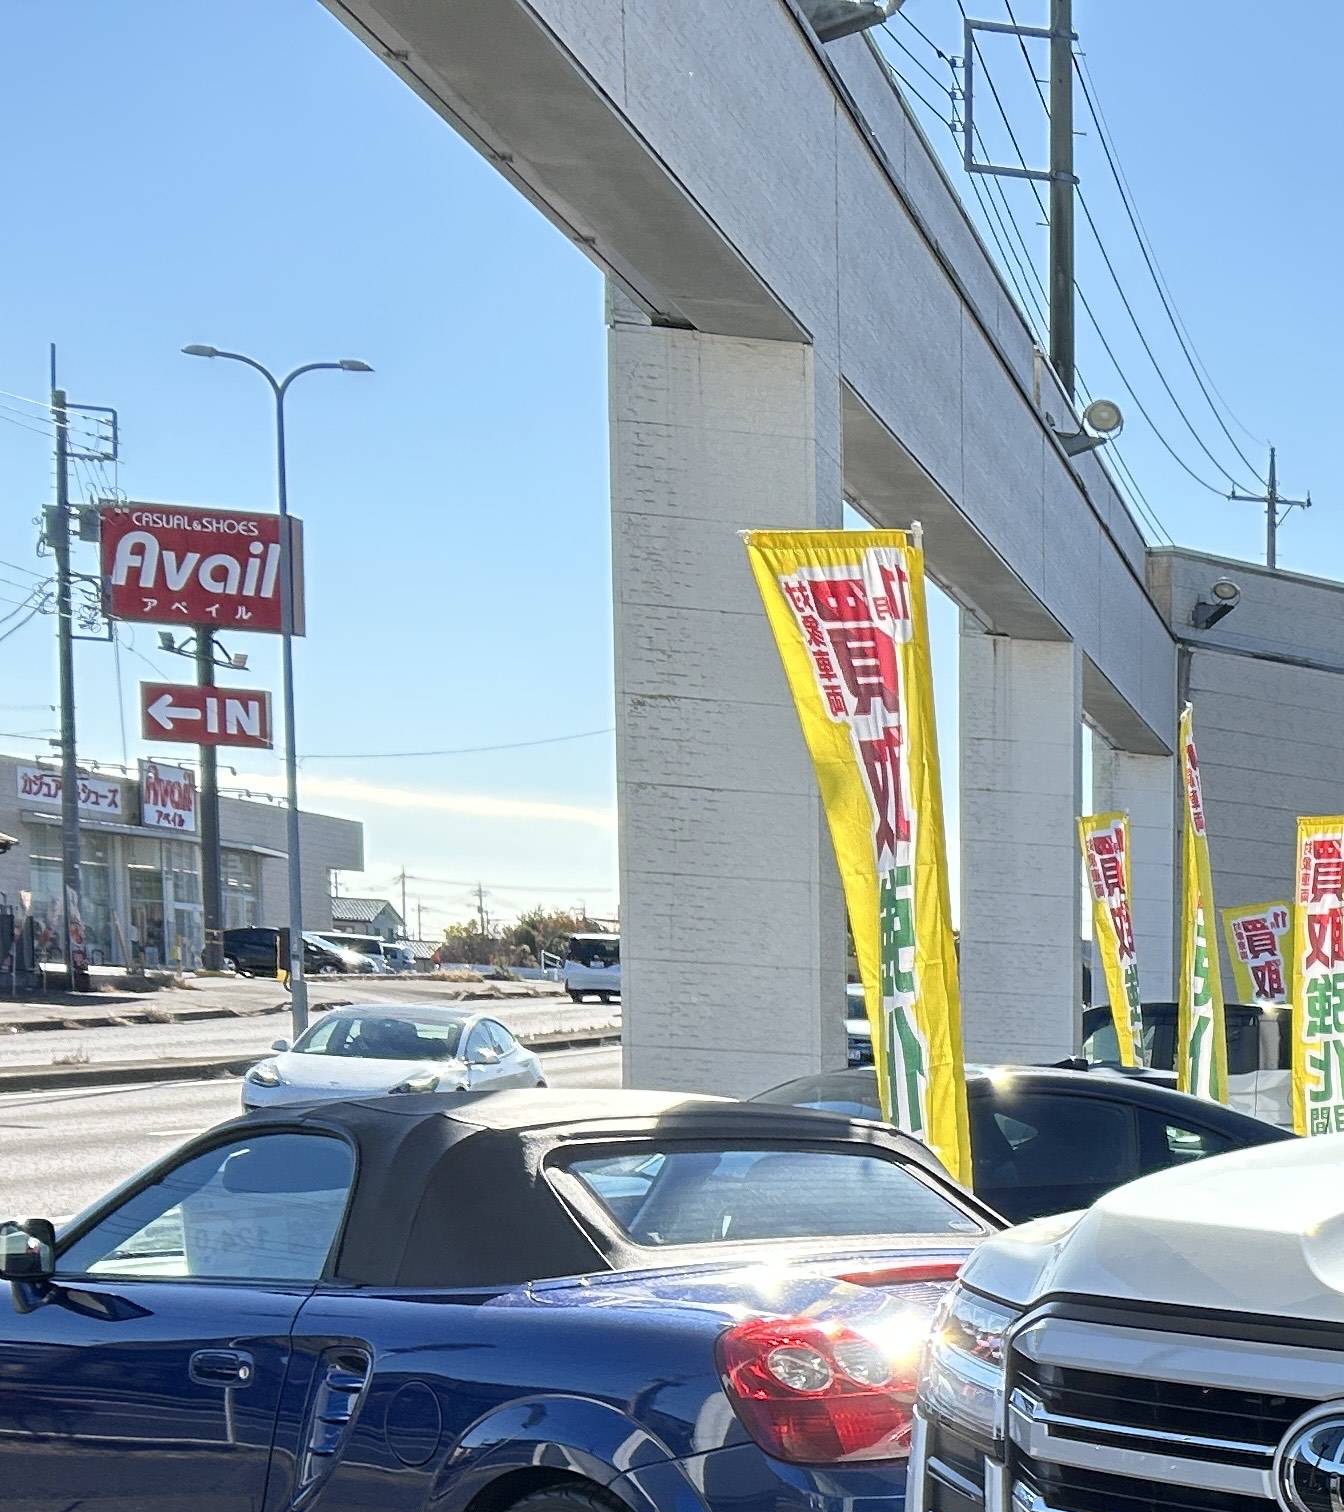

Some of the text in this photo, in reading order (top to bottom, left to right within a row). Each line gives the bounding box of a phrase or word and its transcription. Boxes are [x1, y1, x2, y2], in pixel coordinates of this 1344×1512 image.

[112, 530, 281, 599] Avail
[205, 698, 260, 737] IN
[144, 764, 192, 811] Avail
